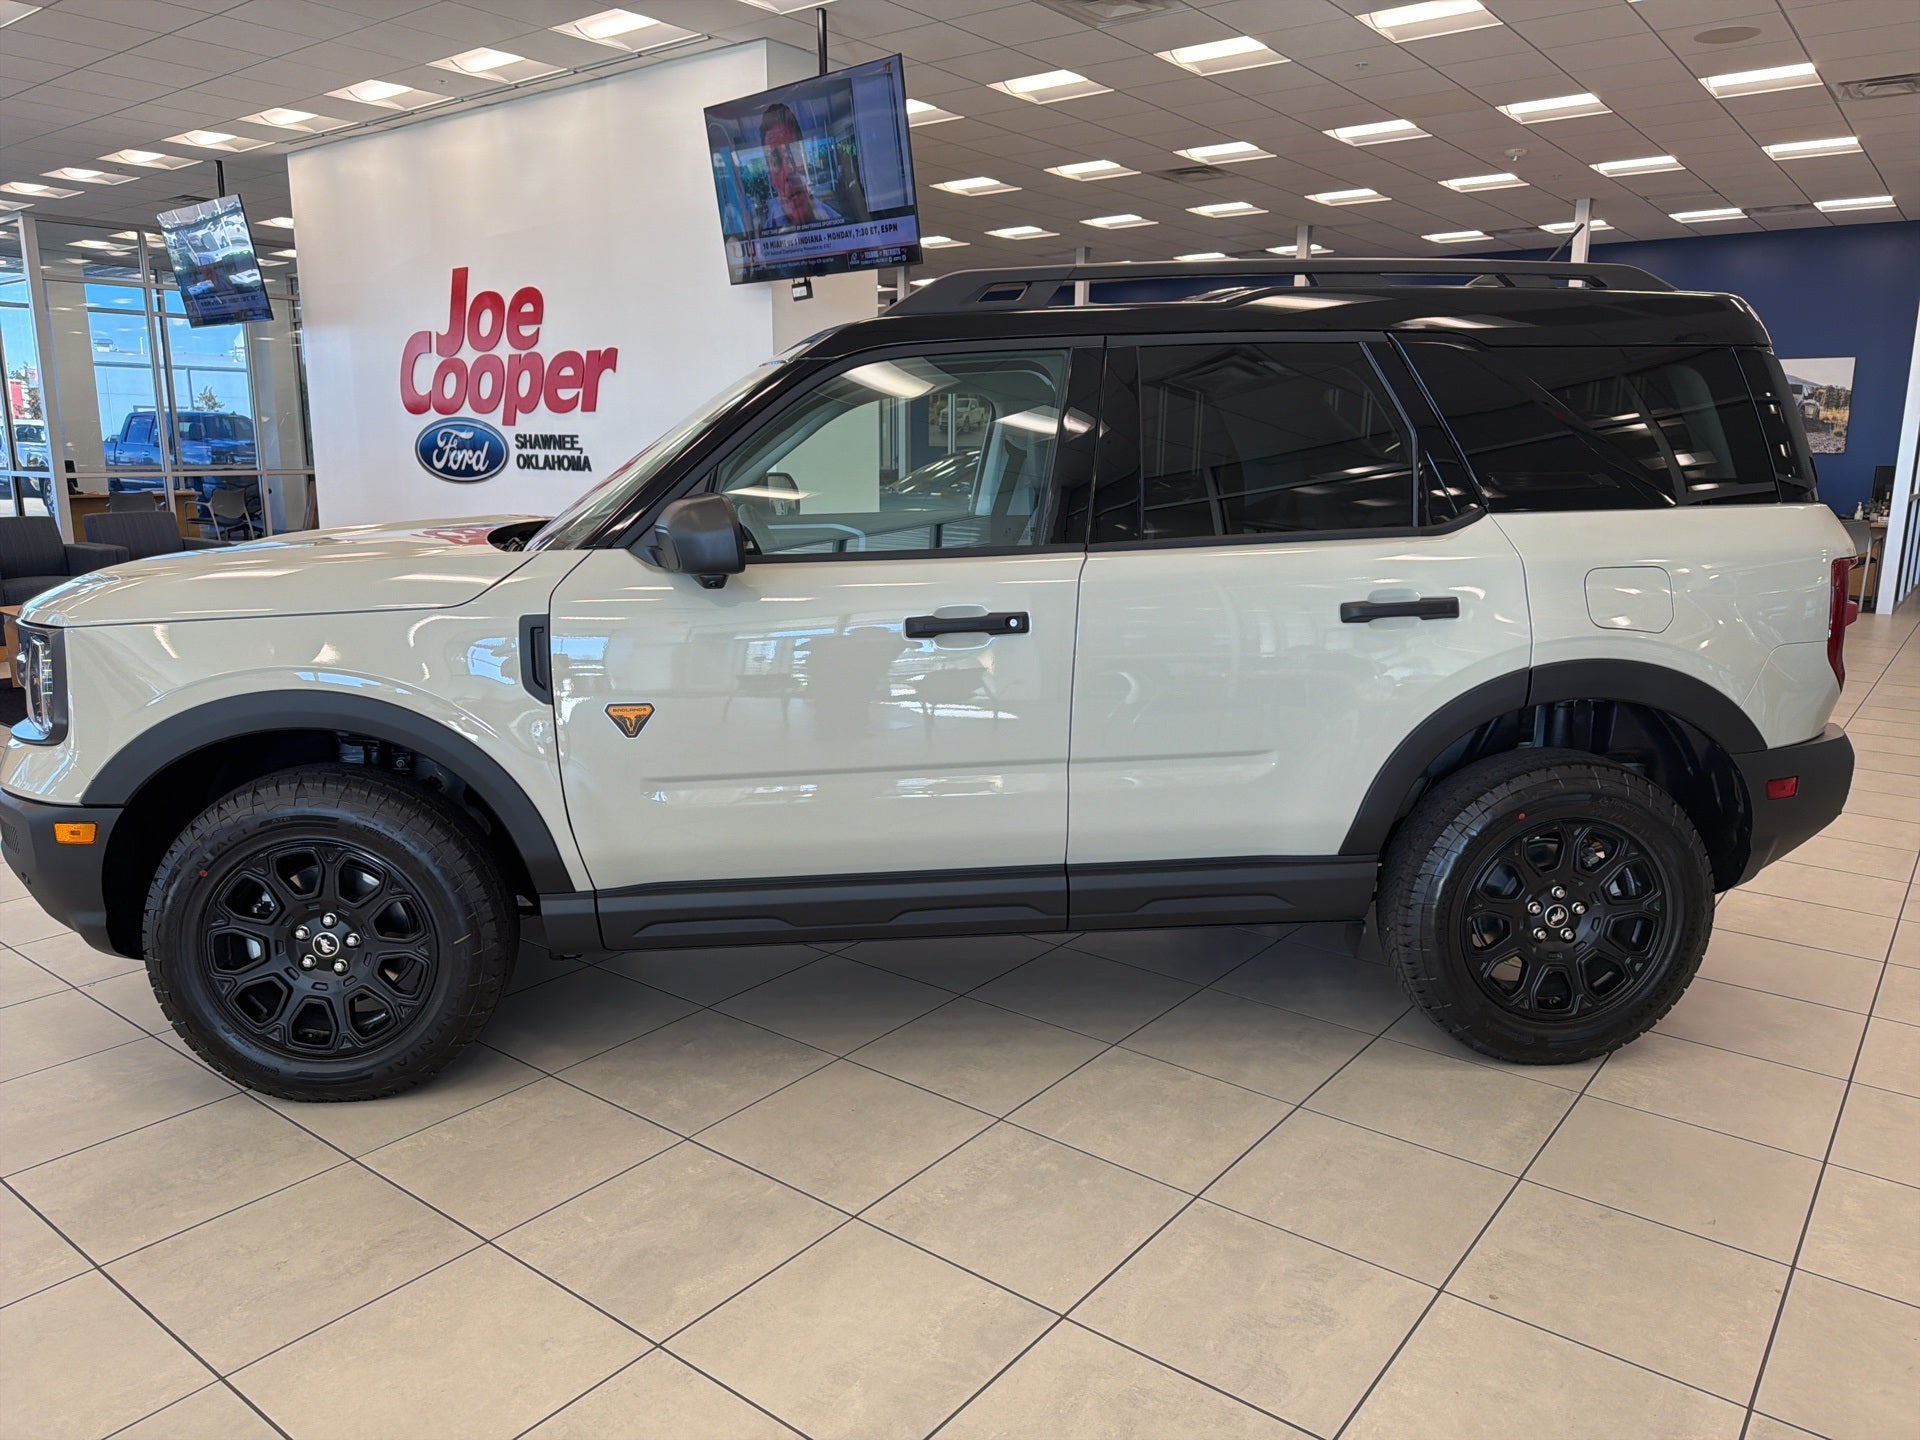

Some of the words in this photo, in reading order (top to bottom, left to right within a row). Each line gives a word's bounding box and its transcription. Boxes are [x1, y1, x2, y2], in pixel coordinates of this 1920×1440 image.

[798, 234, 823, 246] INDIANA
[826, 229, 854, 242] MONDAY,
[855, 226, 868, 237] 7:30
[880, 224, 898, 234] ESPN
[436, 266, 544, 357] Joe
[400, 330, 618, 426] Cooper
[432, 428, 490, 472] Ford
[515, 433, 583, 454] SHAWNEE,
[516, 454, 592, 472] OKLAHOMA
